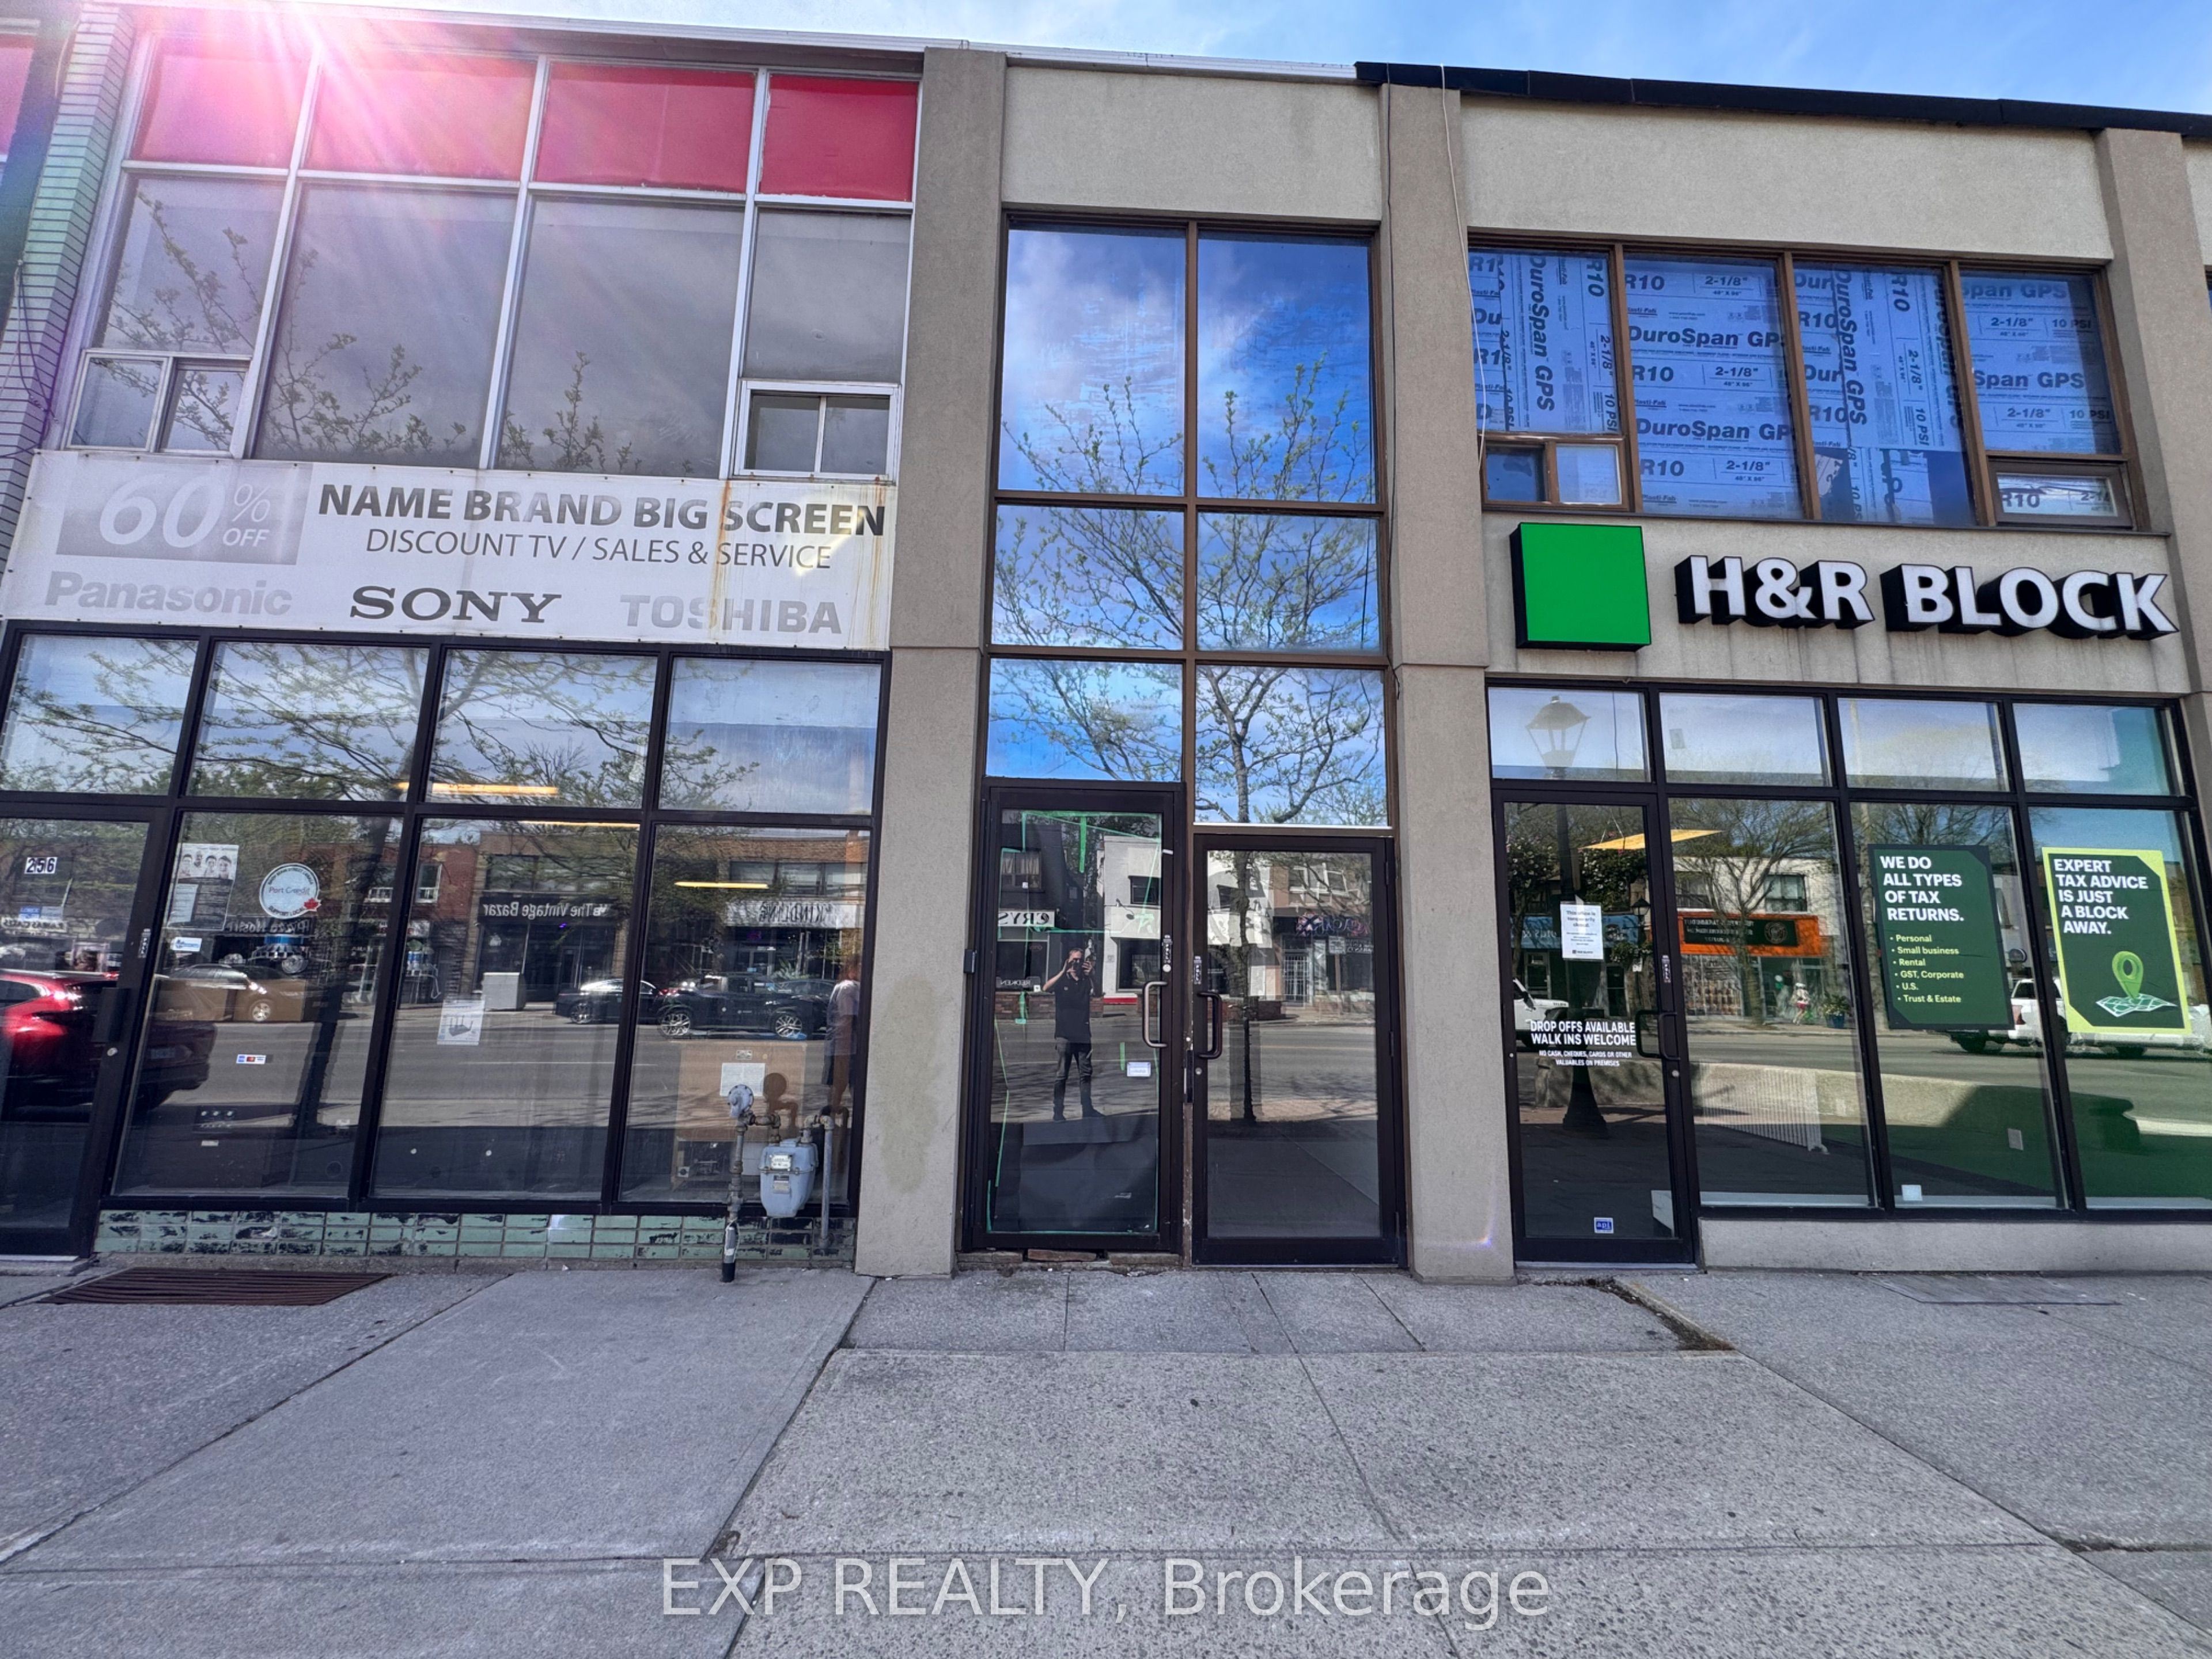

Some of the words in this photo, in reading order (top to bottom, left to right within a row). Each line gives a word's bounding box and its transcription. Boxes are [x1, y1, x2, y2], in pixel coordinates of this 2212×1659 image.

[1470, 256, 1496, 272] R1
[1625, 274, 1665, 290] R10
[1705, 276, 1748, 286] 2-1/8"
[1794, 271, 1833, 289] Dur
[2021, 282, 2067, 298] GPS
[1529, 256, 1550, 357] DuroSpan
[1472, 308, 1502, 325] Du
[1798, 311, 1838, 329] R10
[1991, 317, 2034, 327] 2-1/8"
[2052, 319, 2067, 327] 10
[2073, 320, 2092, 329] PSI
[1628, 325, 1739, 347] DuroSpan
[1747, 331, 1785, 347] GP
[1474, 348, 1501, 365] R1
[1601, 335, 1613, 376] 2-1/8"
[1633, 365, 1674, 382] R10
[1715, 366, 1759, 377] 2-1/8"
[1804, 364, 1843, 382] Dur
[1908, 350, 1923, 391] 2-1/8"
[1535, 365, 1555, 411] GPS
[2037, 372, 2085, 388] GPS
[1605, 393, 1615, 408] 10
[1846, 380, 1868, 426] GPS
[1915, 407, 1926, 422] 10
[2007, 408, 2051, 418] 2-1/8"
[2069, 410, 2085, 419] 10
[2090, 410, 2111, 420] PSI
[1636, 418, 1750, 441] DuroSpan
[1759, 423, 1793, 441] GP
[1918, 425, 1930, 446] PSI
[1641, 459, 1684, 477] R10
[1726, 460, 1771, 471] 2-1/8"
[2002, 493, 2040, 508] R10
[319, 484, 453, 520] NAME
[464, 488, 623, 527] BRAND
[633, 497, 710, 529] BIG
[722, 501, 885, 537] SCREEN
[222, 528, 270, 548] OFF
[366, 528, 523, 556] DISCOUNT
[528, 535, 567, 558] TV
[571, 536, 586, 560] /
[591, 537, 680, 564] SALES
[687, 541, 709, 565] &
[716, 543, 832, 569] SERVICE
[44, 570, 292, 616] Panasonic
[1676, 555, 1876, 627] H&R
[1885, 564, 2180, 638] BLOCK
[349, 586, 562, 624] SONY
[619, 594, 842, 635] TOSHIBA
[26, 857, 55, 873] 256
[1880, 856, 1906, 869] WE
[1908, 856, 1932, 869] DO
[2054, 859, 2112, 873] EXPERT
[1883, 873, 1912, 886] ALL
[1913, 874, 1963, 887] TYPES
[2055, 874, 2087, 887] TAX
[2090, 875, 2149, 889] ADVICE
[1884, 891, 1907, 903] OF
[1908, 891, 1941, 904] TAX
[2059, 890, 2074, 903] IS
[2077, 890, 2113, 903] JUST
[1887, 907, 1964, 922] RETURNS.
[2061, 905, 2073, 918] A
[2074, 906, 2130, 919] BLOCK
[2063, 921, 2112, 935] AWAY.
[1895, 934, 1933, 942] Personal
[1897, 946, 1921, 955] Small
[1922, 946, 1960, 955] business
[1899, 958, 1926, 966] Rental
[1900, 970, 1920, 979] GST,
[1921, 970, 1965, 980] Corporate
[1902, 982, 1919, 990] U.S.
[1926, 995, 1934, 1003] &
[1934, 995, 1962, 1003] Estate
[1530, 1020, 1557, 1032] DROP
[1559, 1021, 1583, 1033] OFFS
[1585, 1021, 1636, 1033] AVAILABLE
[1531, 1033, 1562, 1044] WALK
[1564, 1033, 1582, 1045] INS
[1584, 1034, 1637, 1046] WELCOME
